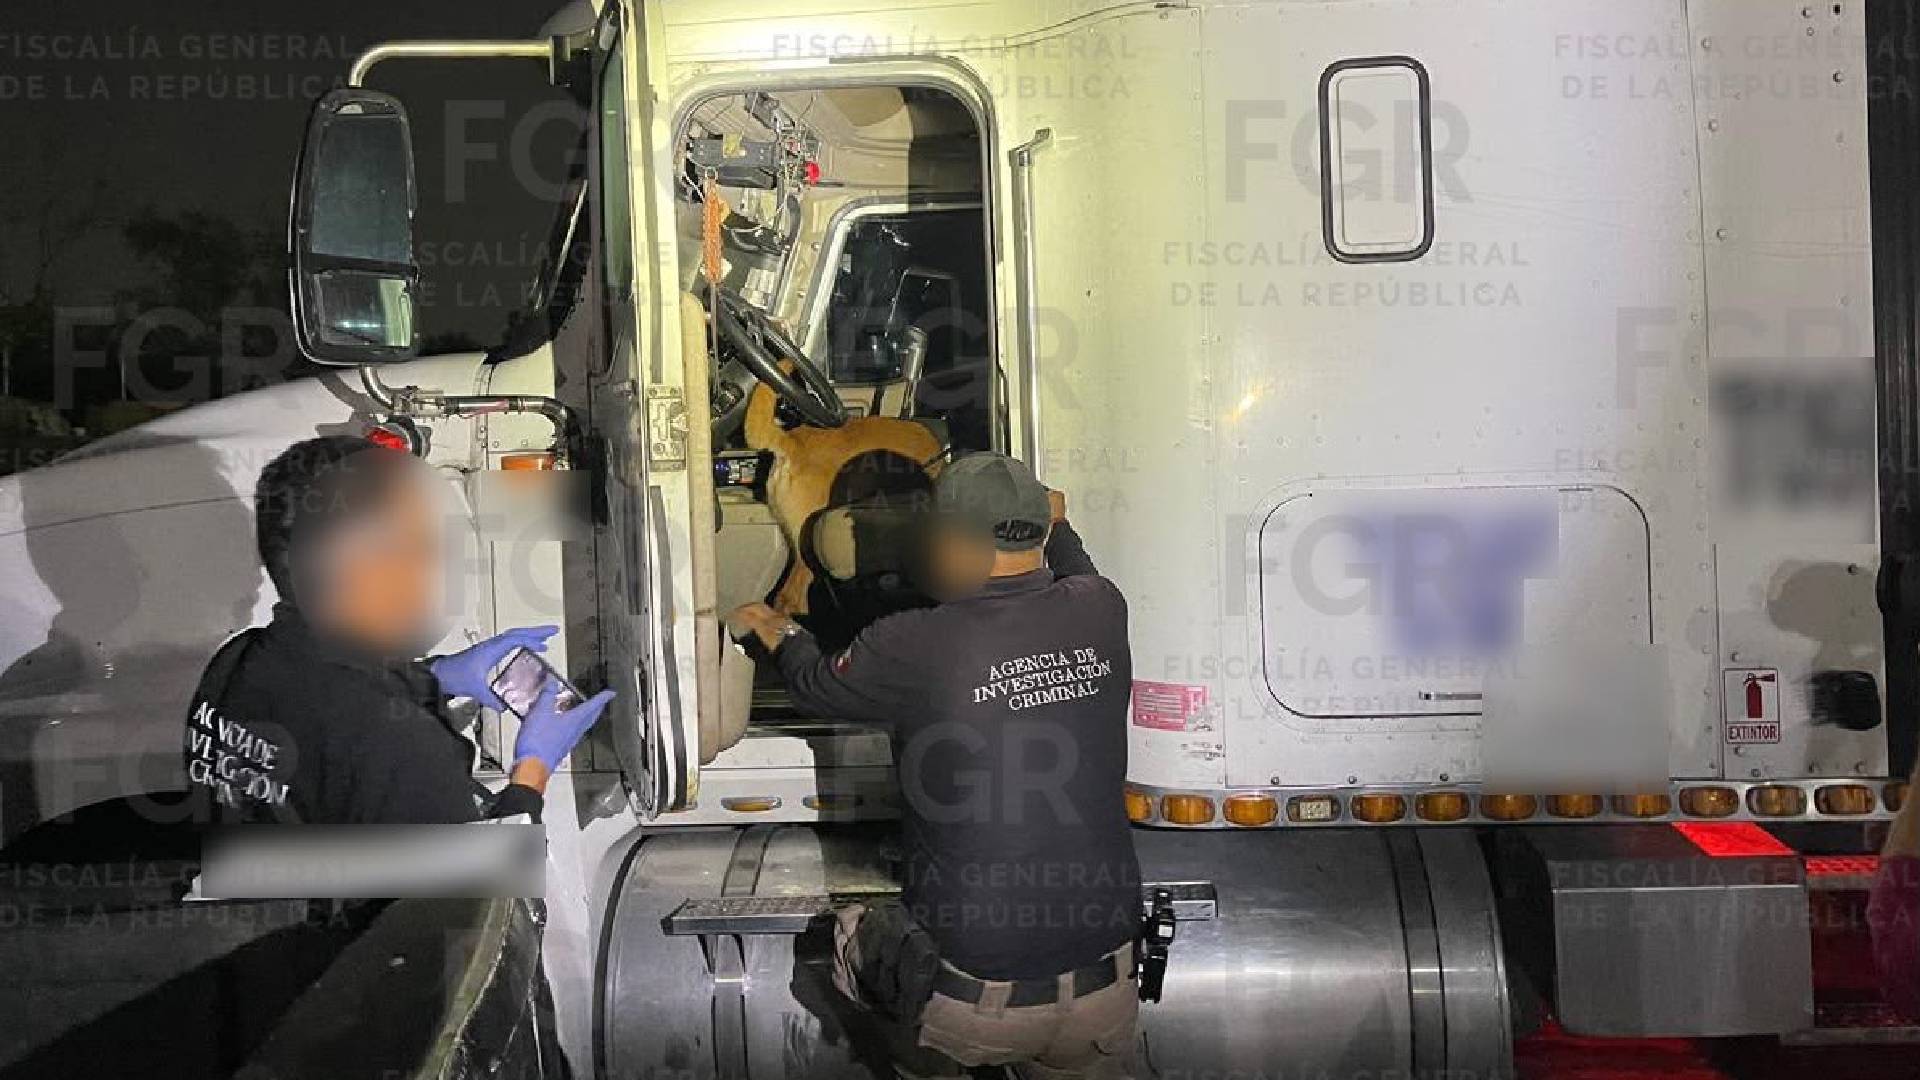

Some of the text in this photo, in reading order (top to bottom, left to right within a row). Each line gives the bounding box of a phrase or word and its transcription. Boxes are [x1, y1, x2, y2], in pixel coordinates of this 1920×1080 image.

[989, 647, 1097, 681] AGENCIA DE
[1008, 681, 1099, 710] CRIMINAL
[1728, 725, 1777, 740] EXTINTOR
